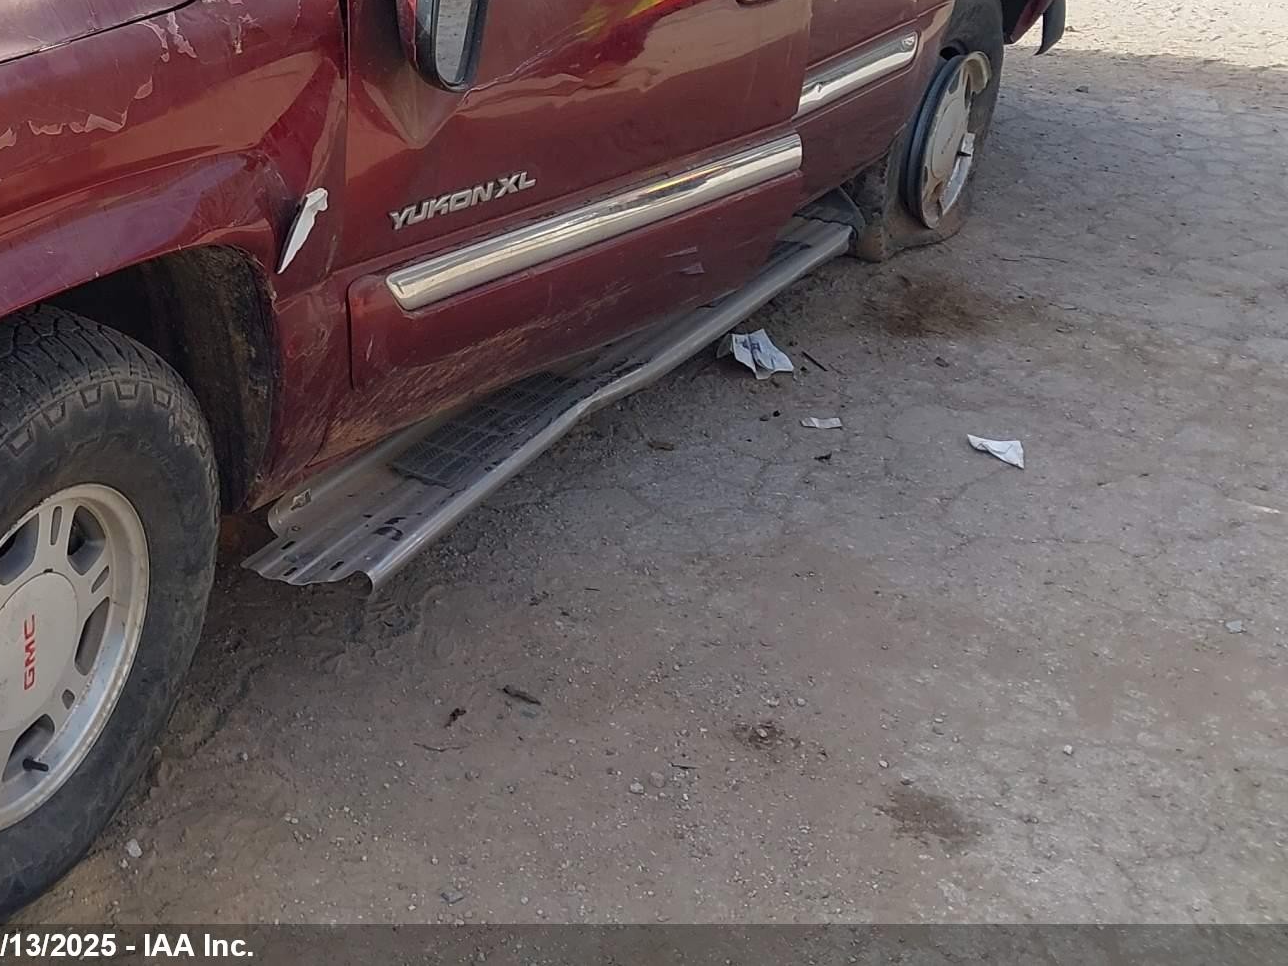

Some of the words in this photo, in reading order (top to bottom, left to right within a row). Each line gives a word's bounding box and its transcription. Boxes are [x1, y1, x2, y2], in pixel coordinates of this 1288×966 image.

[389, 181, 495, 231] YUKON
[495, 170, 537, 200] XL
[23, 613, 36, 691] GMC
